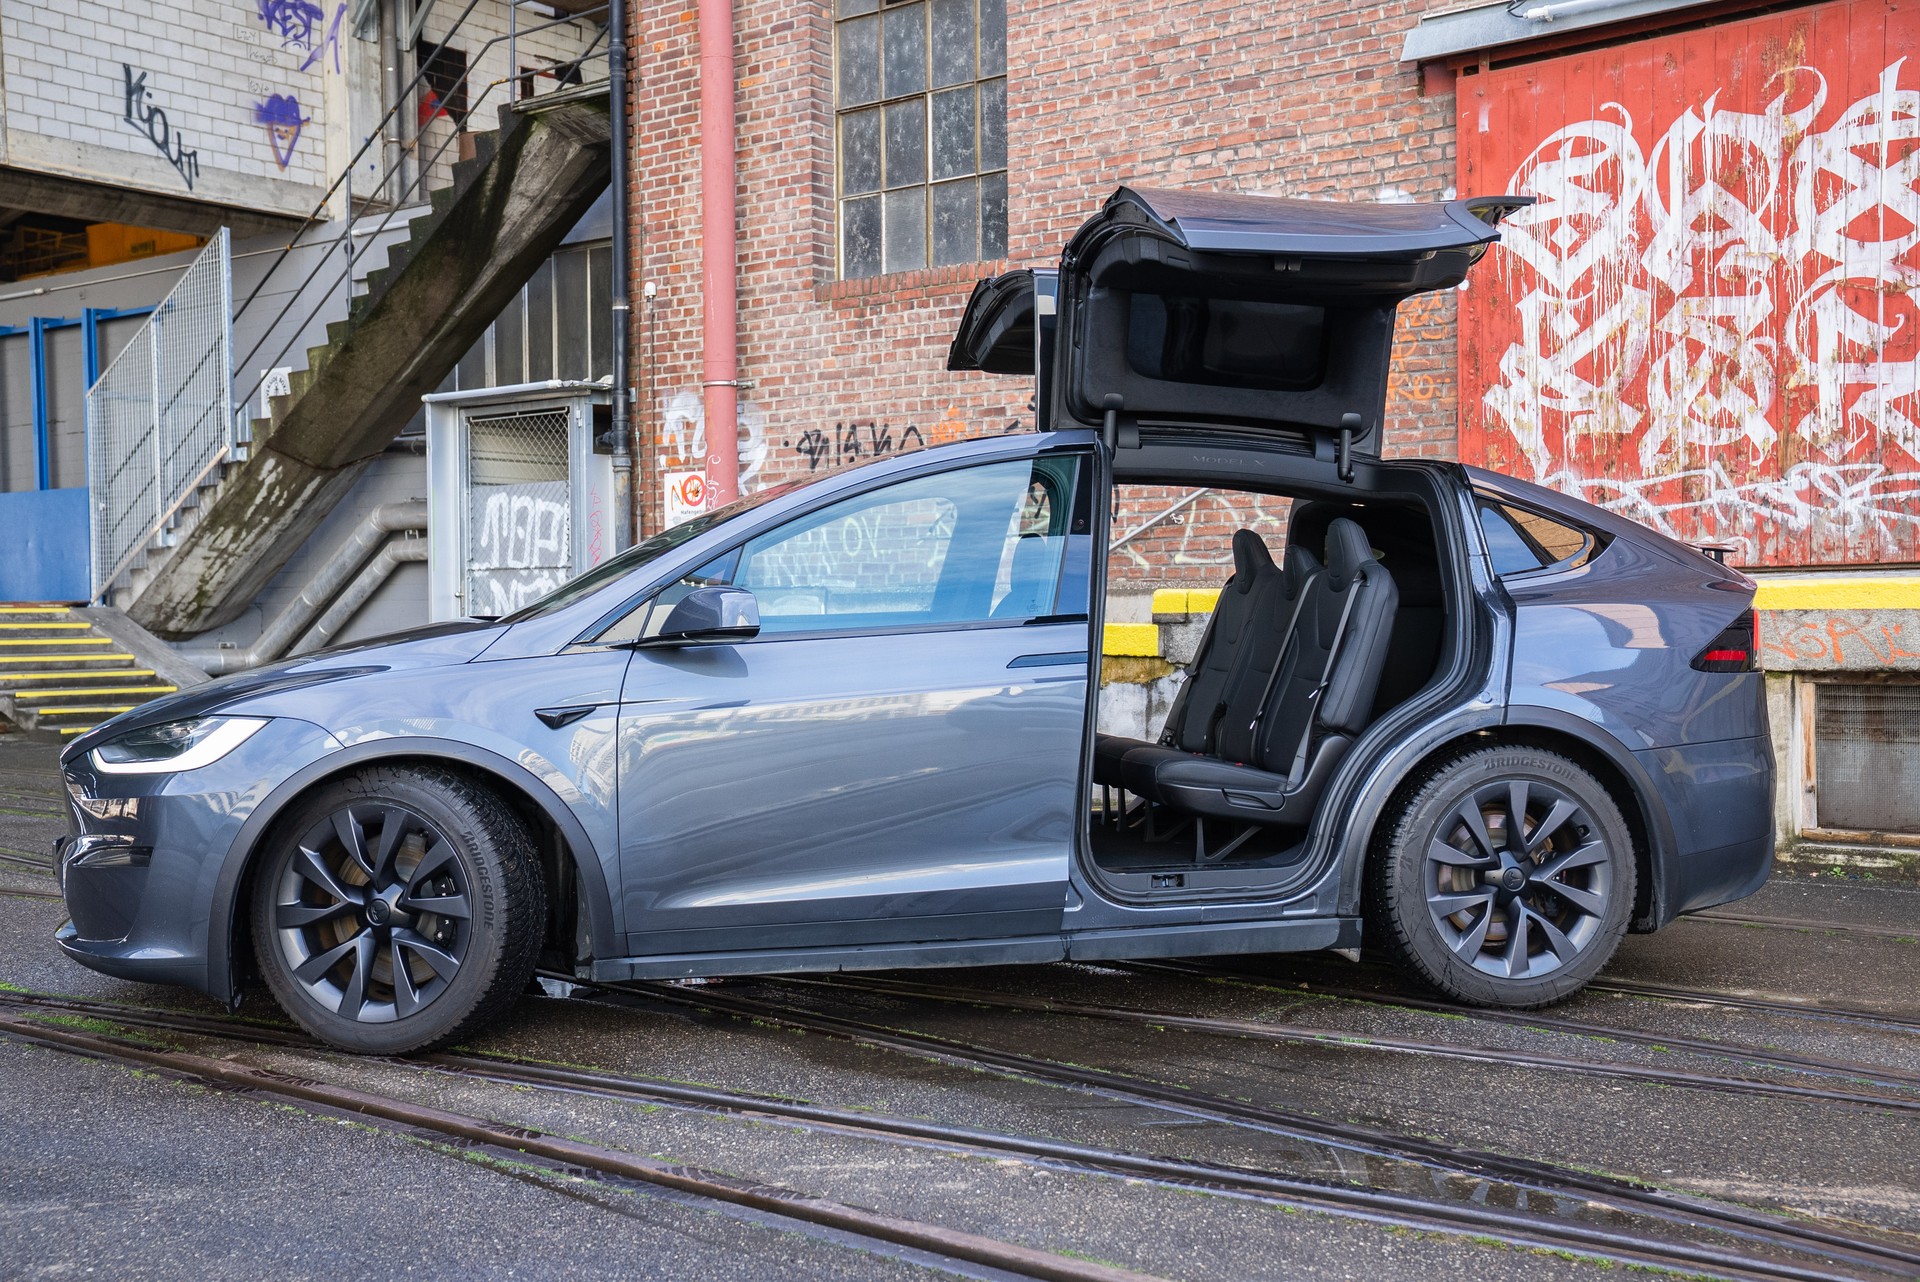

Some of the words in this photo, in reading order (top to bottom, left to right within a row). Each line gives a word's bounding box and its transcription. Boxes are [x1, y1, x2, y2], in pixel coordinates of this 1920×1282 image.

[1254, 459, 1266, 467] X
[1484, 756, 1579, 781] BRIDGESTONE
[460, 830, 495, 931] BRIDGESTONE
